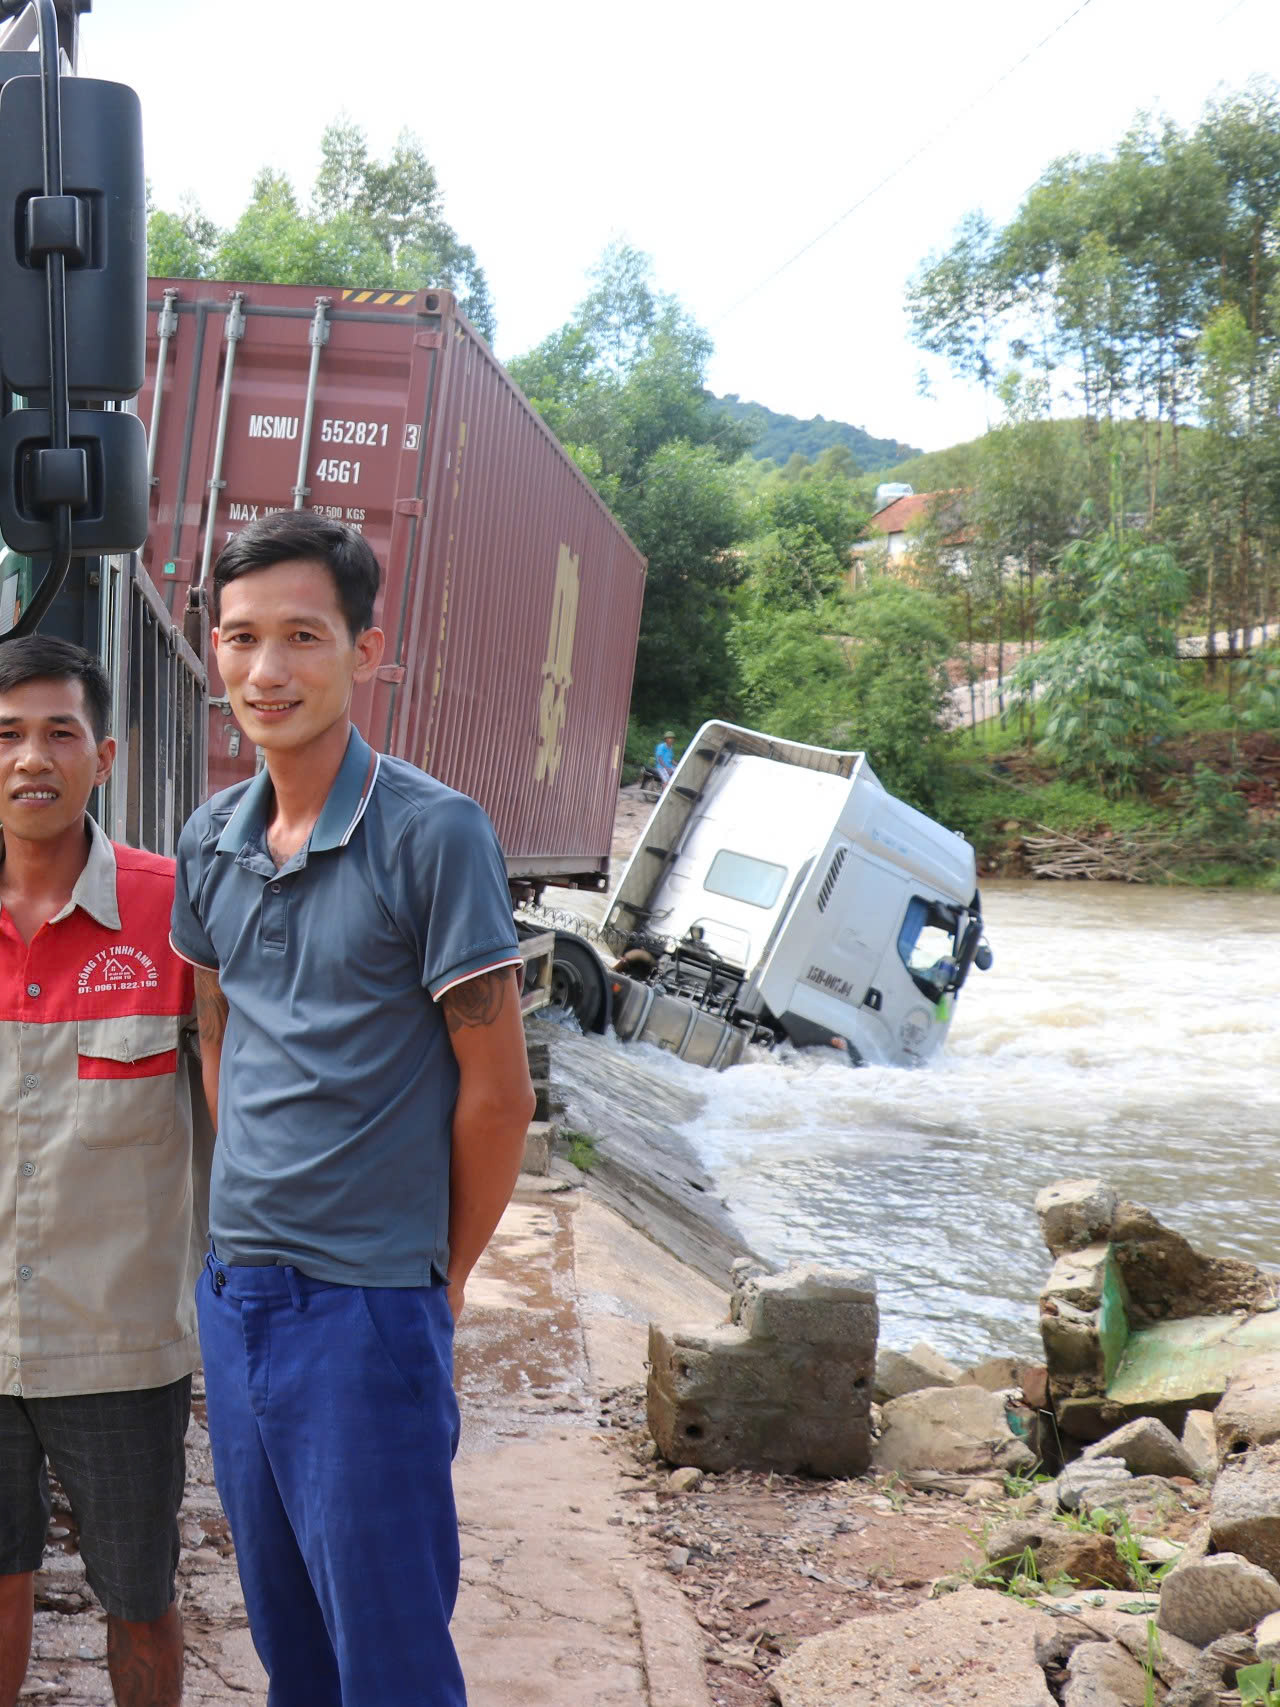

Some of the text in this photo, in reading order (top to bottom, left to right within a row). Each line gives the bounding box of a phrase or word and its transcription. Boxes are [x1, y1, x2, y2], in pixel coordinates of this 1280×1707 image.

[248, 414, 419, 449] MSMU 552821 3
[315, 458, 361, 485] 45G1
[229, 502, 259, 521] MAX
[346, 507, 366, 521] KGS
[78, 959, 97, 986] CÔNG
[95, 950, 107, 962] TY
[109, 946, 134, 956] TNHH
[135, 951, 152, 968] ANH
